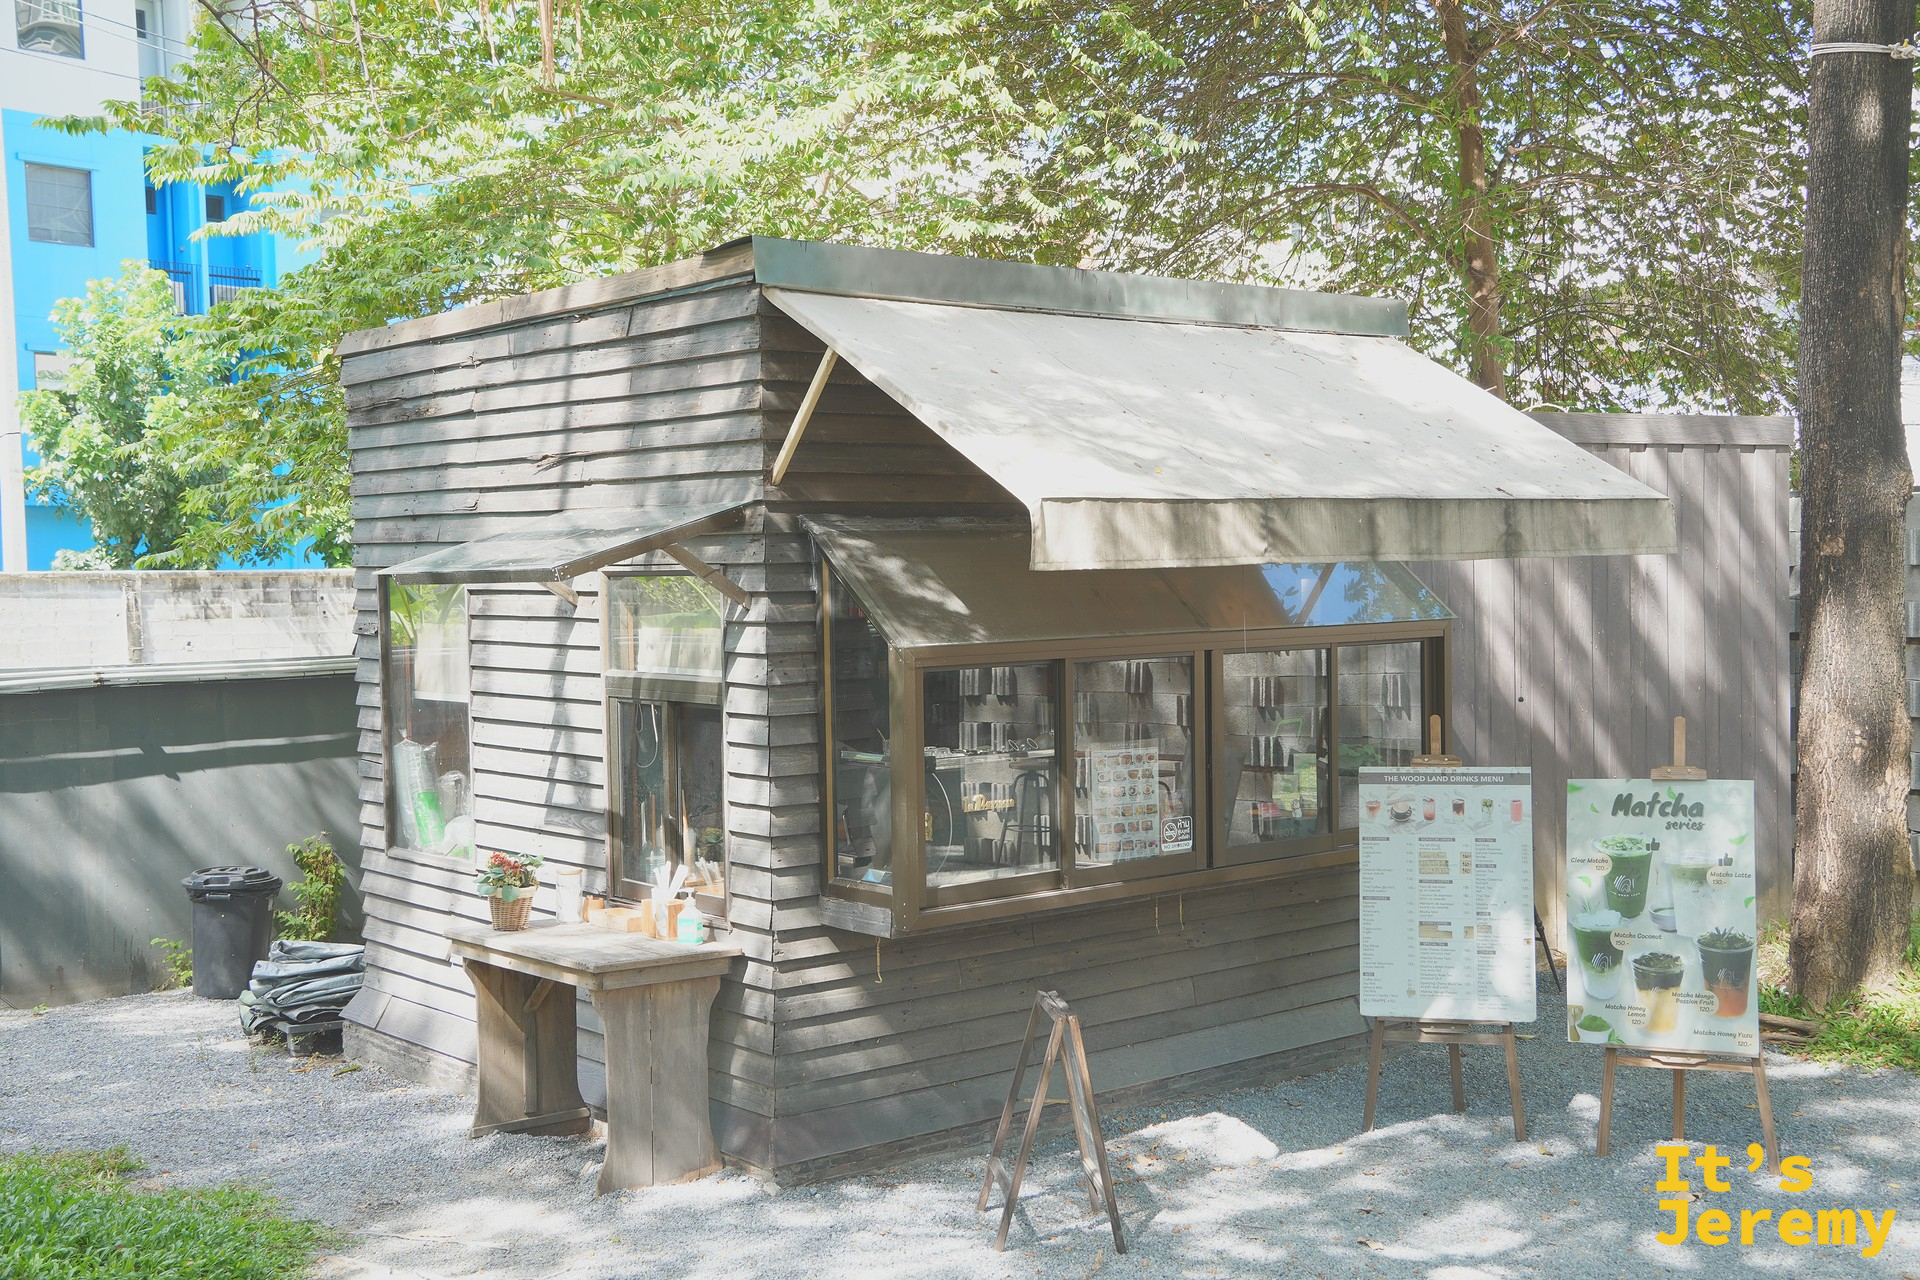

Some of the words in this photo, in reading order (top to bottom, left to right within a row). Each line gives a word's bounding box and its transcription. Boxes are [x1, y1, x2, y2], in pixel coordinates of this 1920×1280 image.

[1611, 792, 1704, 818] Matcha
[1665, 818, 1704, 831] series
[1628, 1005, 1646, 1013] Honey
[1717, 1030, 1736, 1039] Honey
